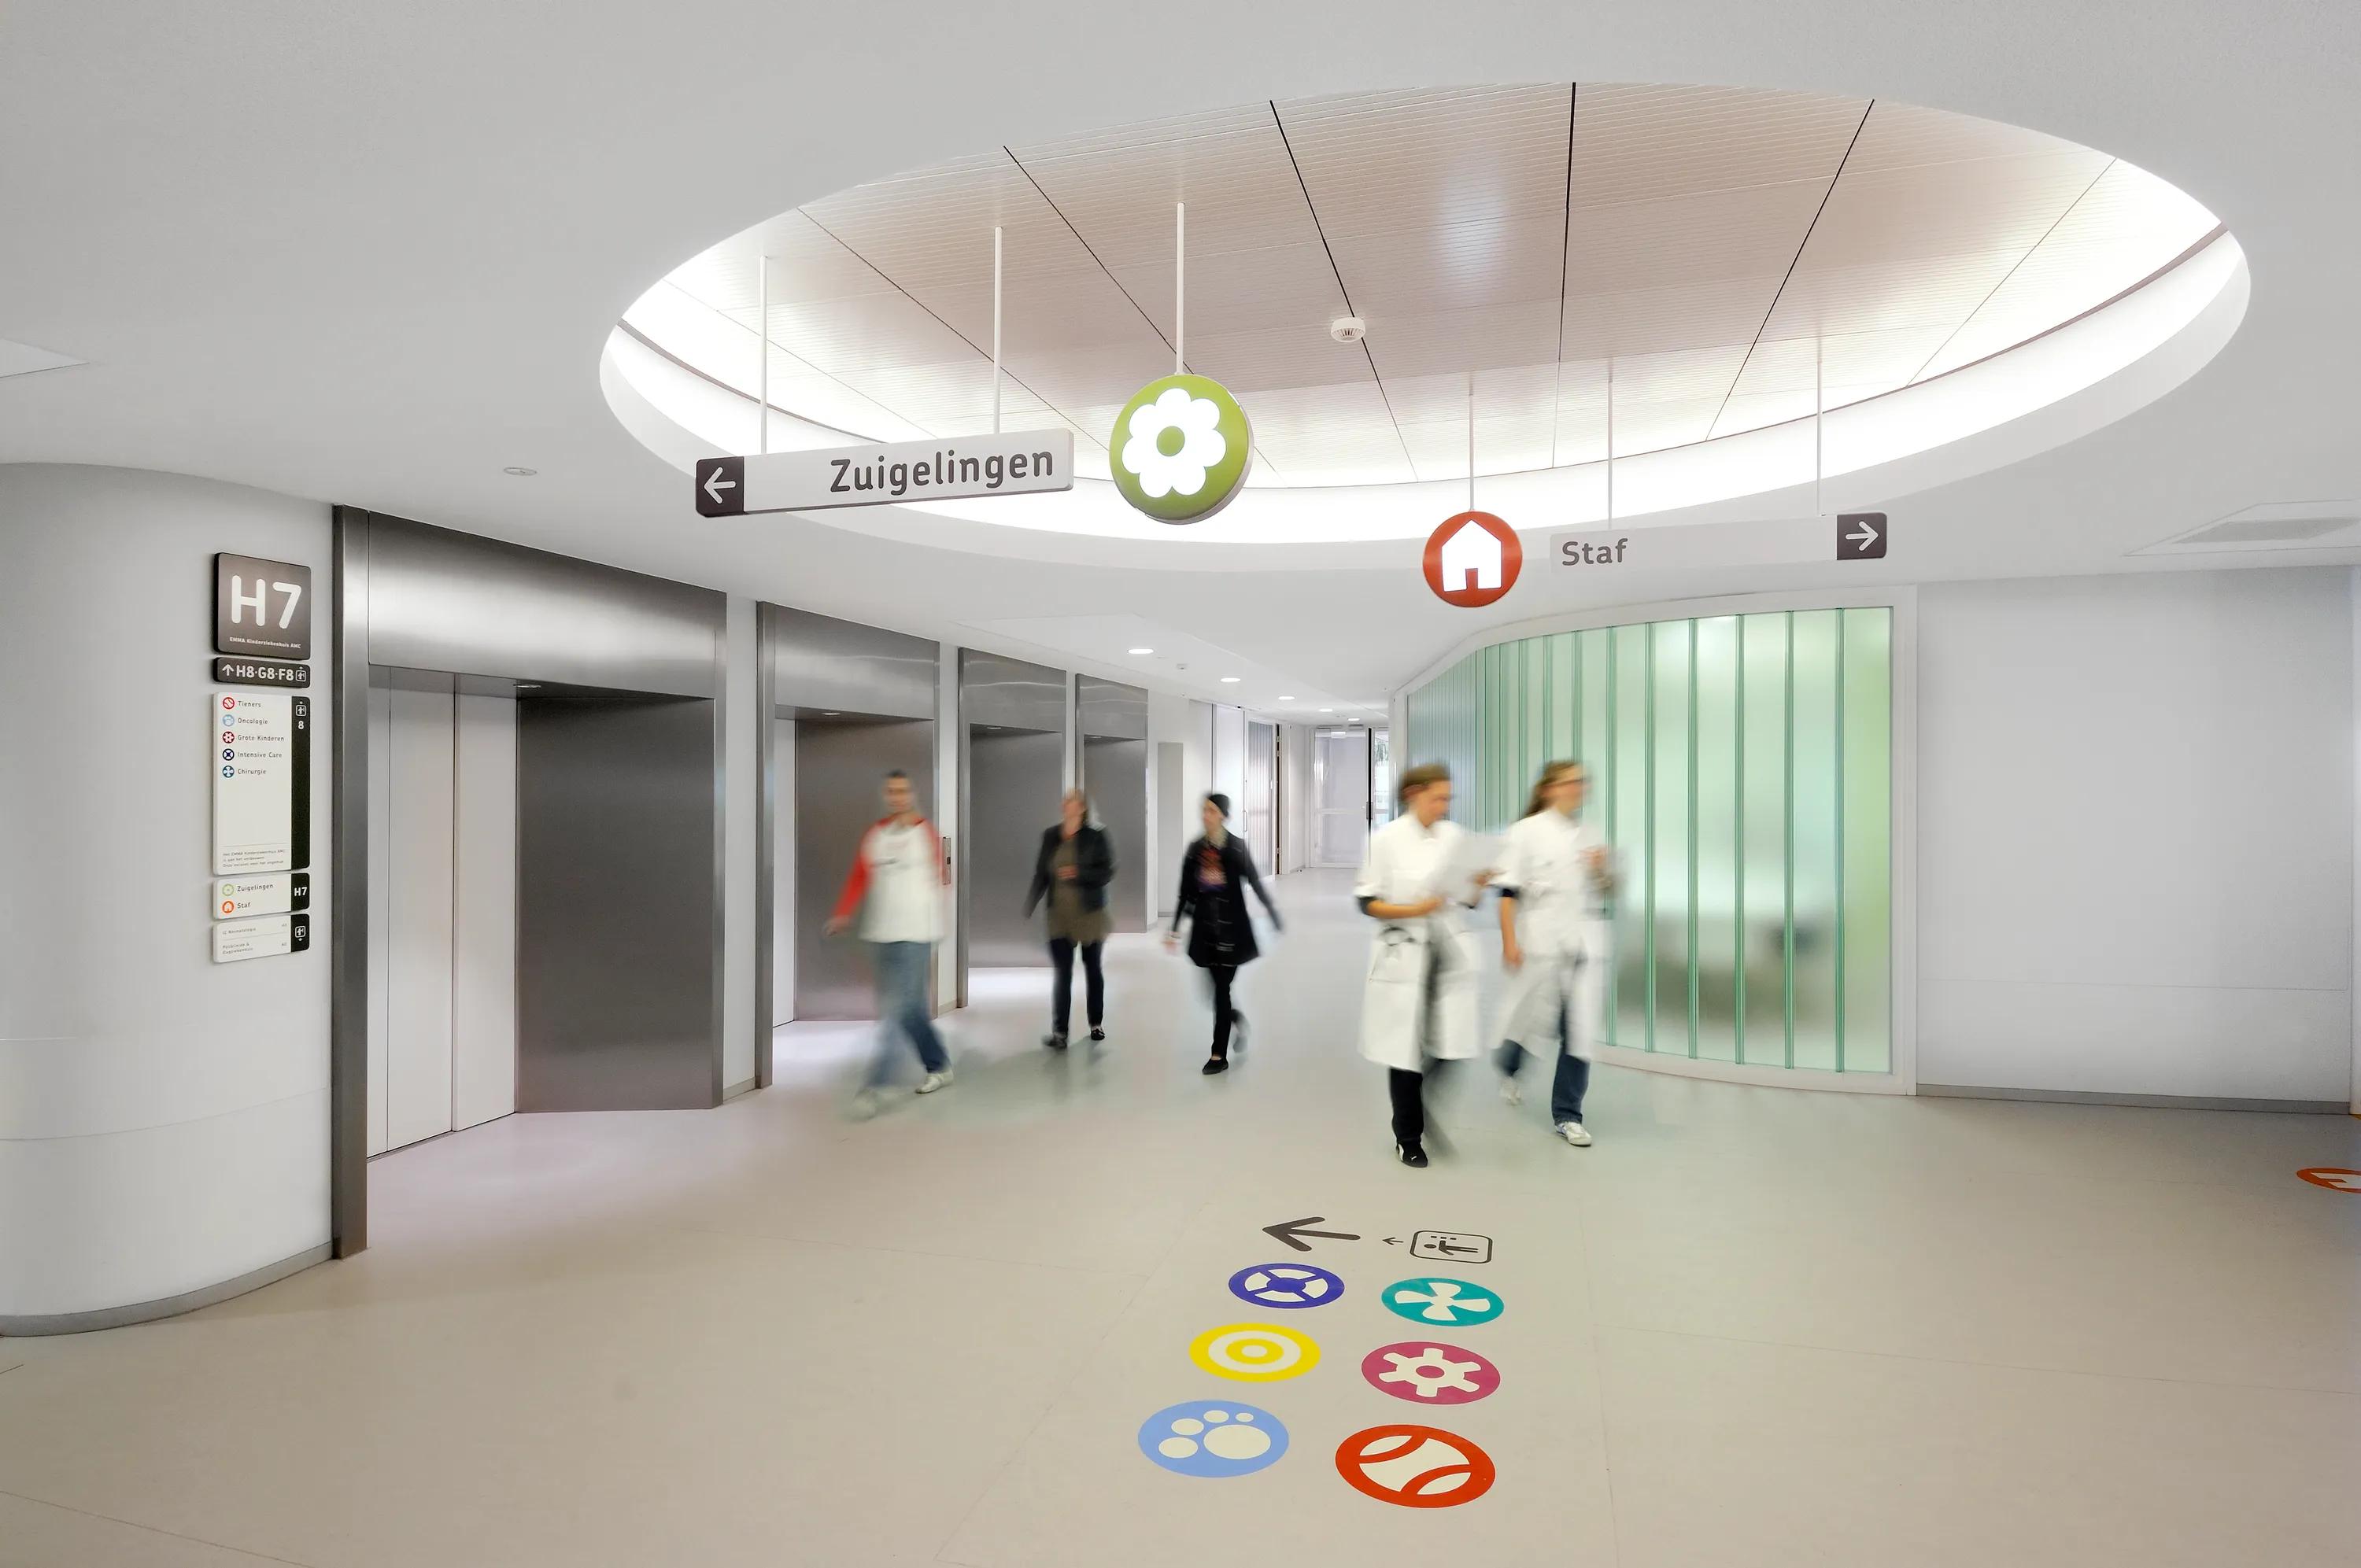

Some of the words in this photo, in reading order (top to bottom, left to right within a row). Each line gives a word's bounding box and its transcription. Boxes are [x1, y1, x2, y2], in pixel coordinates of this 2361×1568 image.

[830, 449, 1053, 496] Zuigelingen
[1561, 537, 1628, 566] Staf
[231, 574, 302, 629] H7
[297, 720, 305, 730] 8
[237, 883, 274, 893] Zuigelingen
[294, 887, 308, 897] H7
